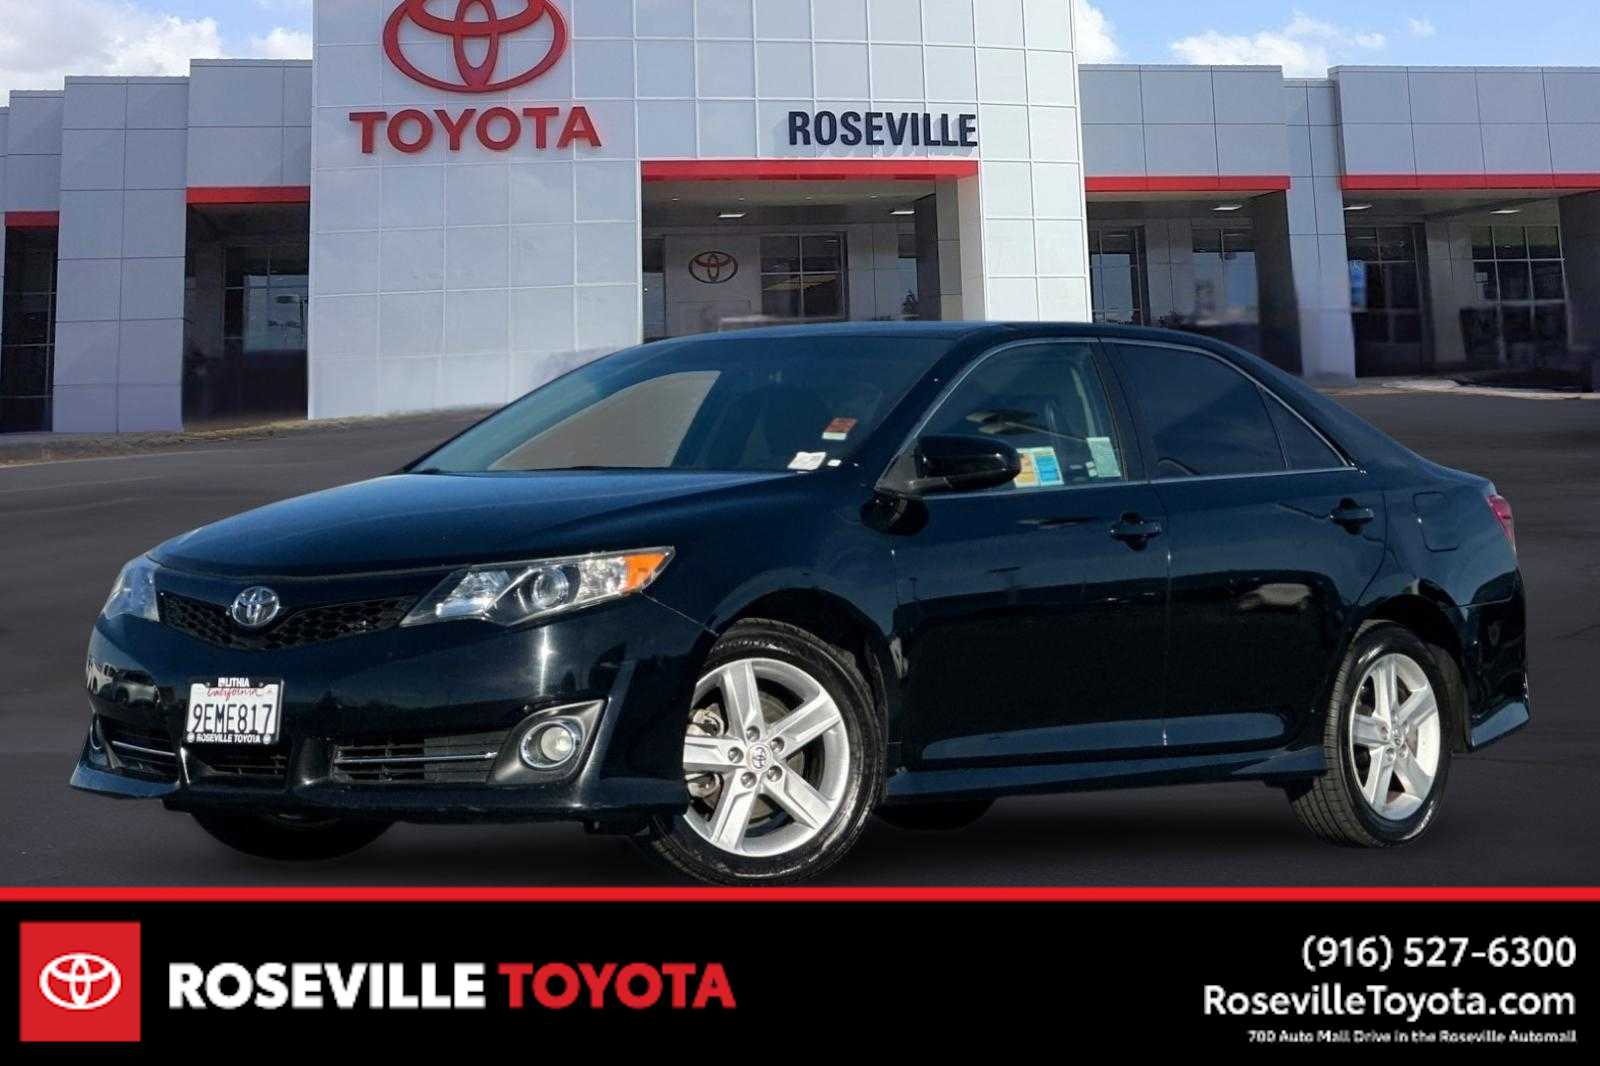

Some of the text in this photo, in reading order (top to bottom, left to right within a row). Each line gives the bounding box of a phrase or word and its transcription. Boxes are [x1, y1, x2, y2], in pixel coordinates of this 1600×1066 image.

[349, 106, 602, 154] TOYOTA
[788, 111, 978, 147] ROSEVILLE
[192, 703, 274, 734] 9EME817
[196, 733, 261, 743] ROSEVILLE TOYOTA
